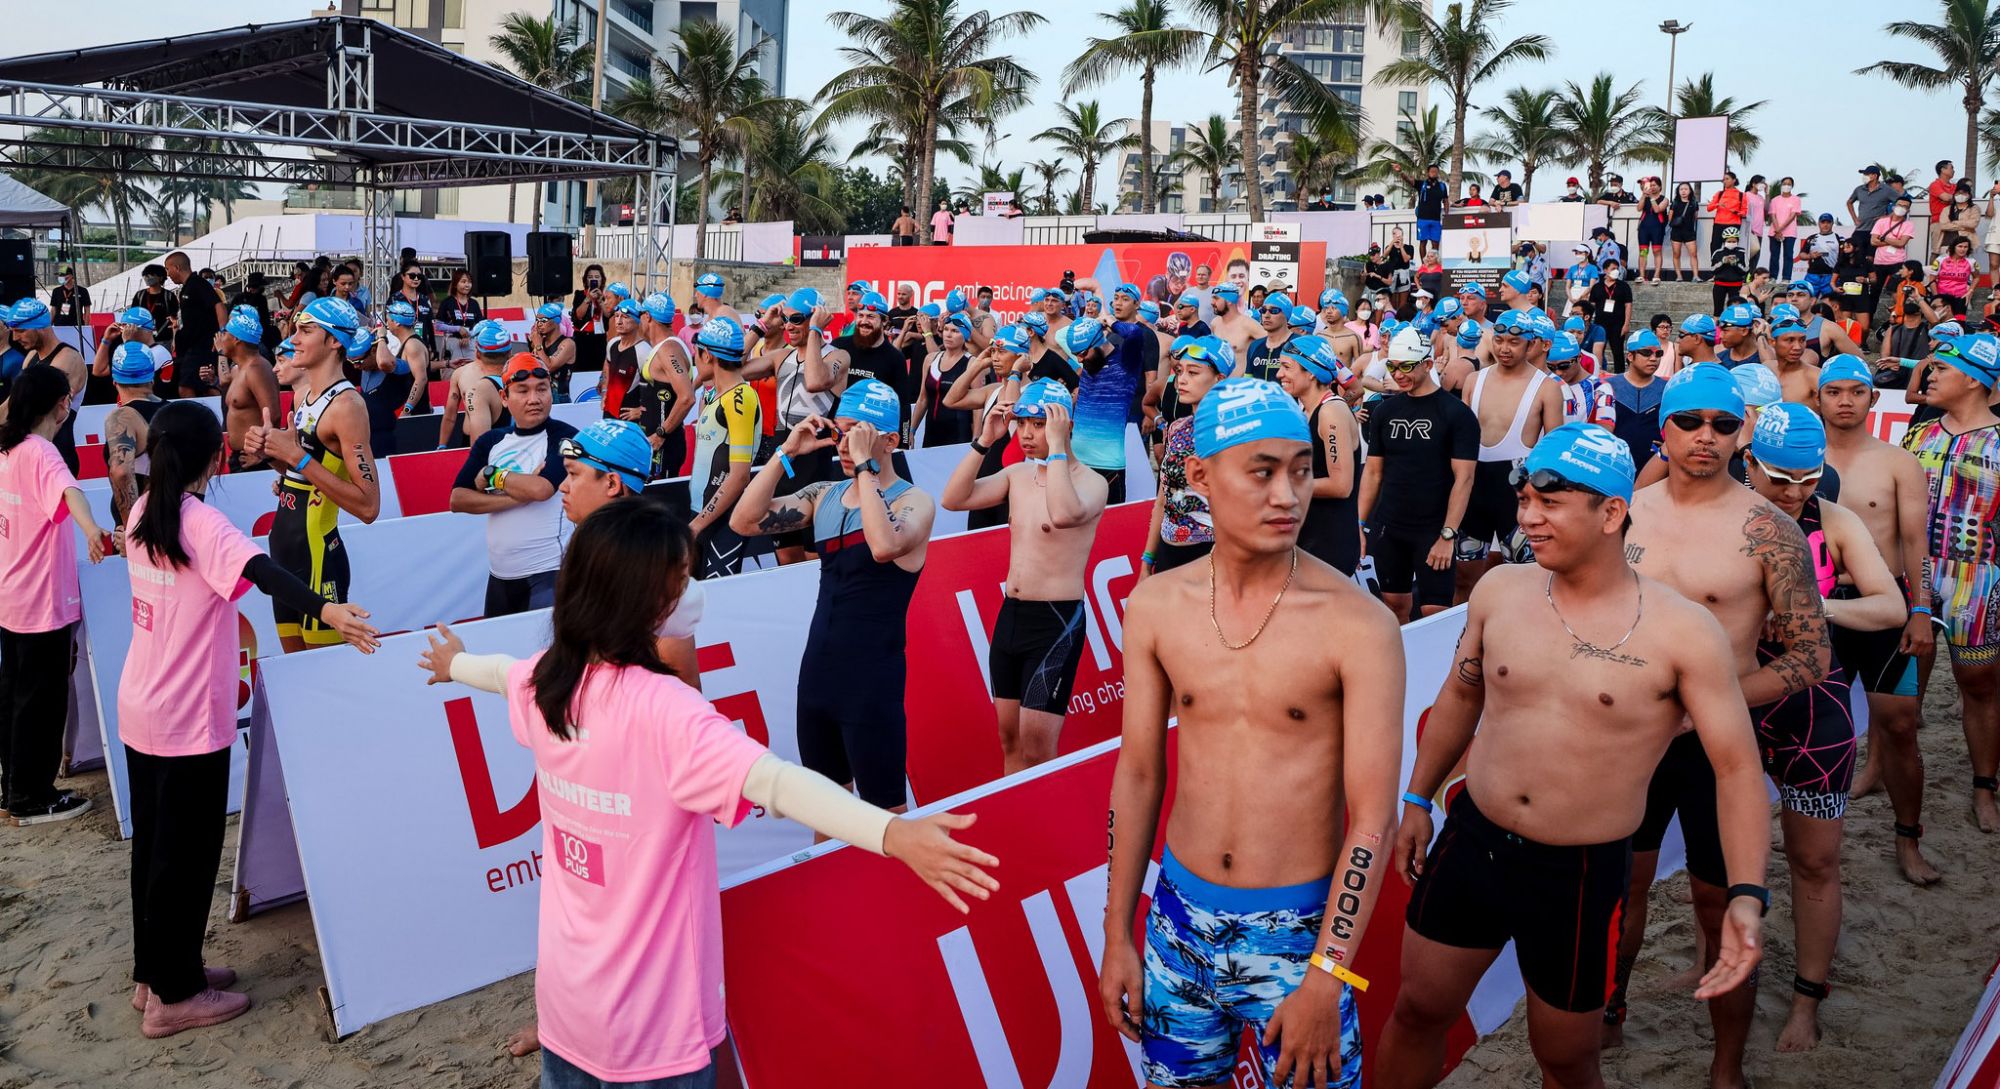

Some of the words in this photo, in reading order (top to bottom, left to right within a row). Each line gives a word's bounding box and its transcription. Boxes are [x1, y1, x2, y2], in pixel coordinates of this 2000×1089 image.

[803, 244, 841, 260] IRONMAN
[1389, 419, 1432, 439] TYR
[1328, 434, 1337, 463] 247
[561, 832, 589, 865] 100
[565, 858, 590, 880] PLUS
